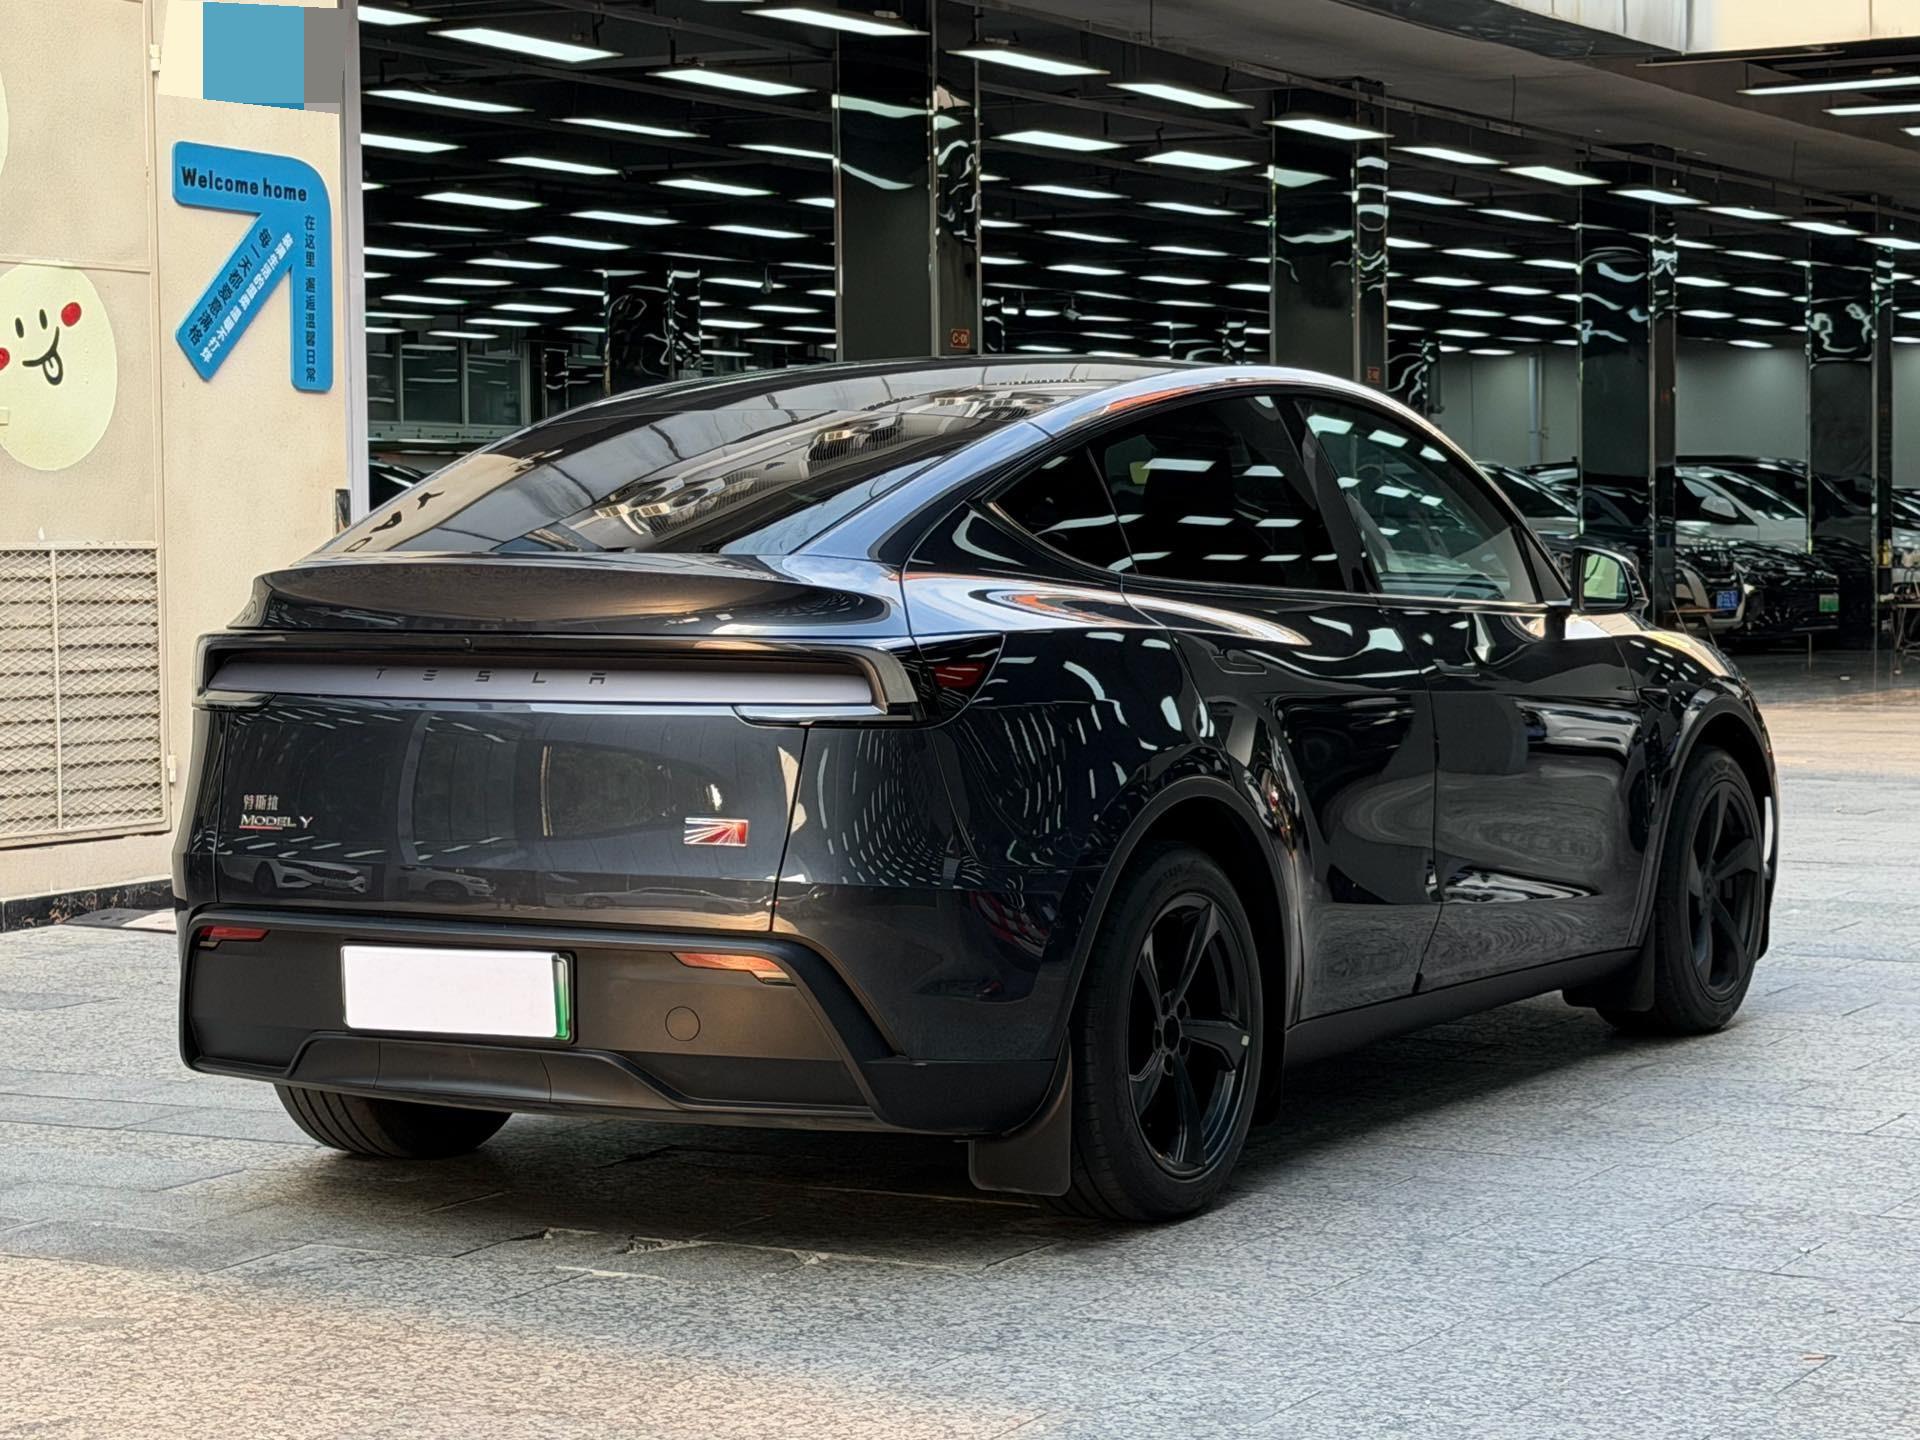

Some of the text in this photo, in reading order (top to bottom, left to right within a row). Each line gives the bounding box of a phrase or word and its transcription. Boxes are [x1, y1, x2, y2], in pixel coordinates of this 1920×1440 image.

[181, 166, 307, 201] Welcome home
[304, 214, 316, 268] 在这里
[188, 227, 272, 346] 每一天都爱意满格
[375, 667, 607, 684] TESLA
[243, 794, 279, 811] 特斯拉
[241, 813, 313, 829] MODEL Y
